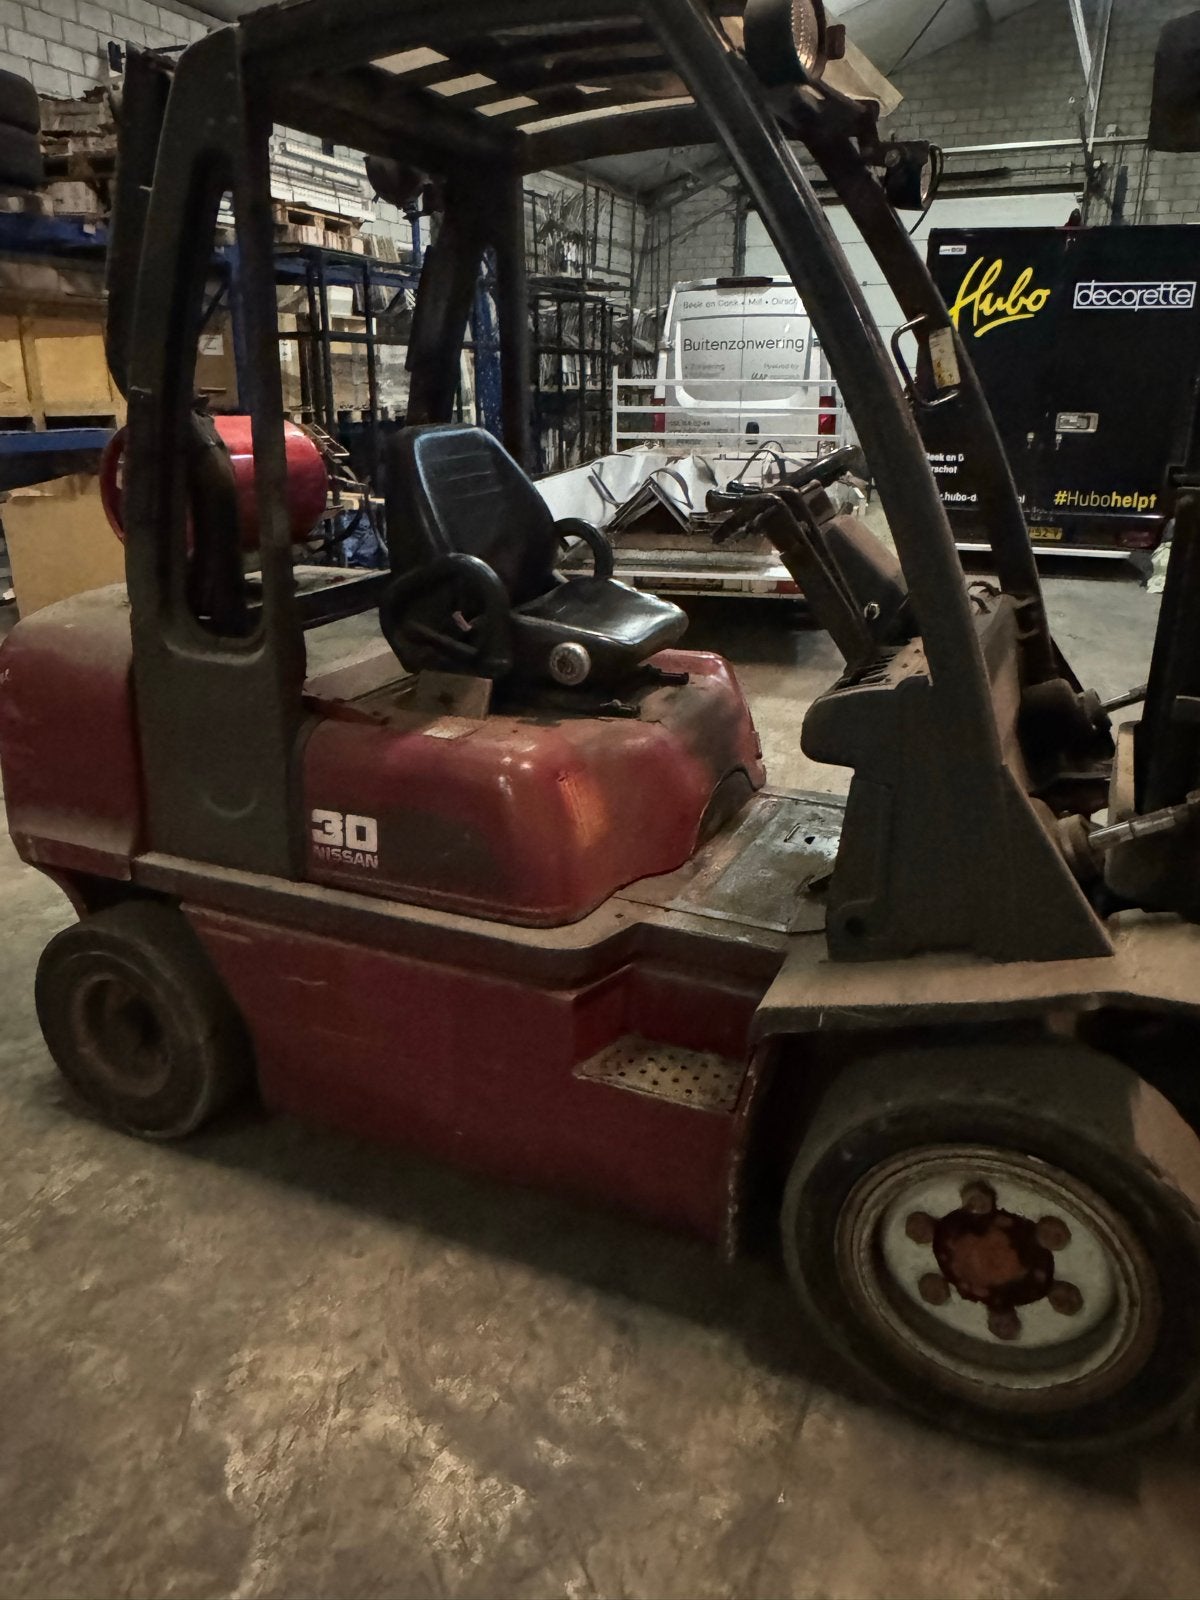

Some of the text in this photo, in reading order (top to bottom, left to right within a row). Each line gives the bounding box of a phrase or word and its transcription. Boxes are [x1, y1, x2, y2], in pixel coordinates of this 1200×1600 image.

[948, 256, 1051, 334] Hubo
[1077, 280, 1192, 312] decorette
[683, 337, 804, 353] Buitenzonwering
[946, 454, 957, 462] en
[931, 465, 958, 474] rschot
[939, 492, 977, 502] .hubo-d
[1054, 490, 1157, 511] #Hubohelpt
[311, 808, 378, 853] 30
[312, 845, 379, 869] NISSAN
